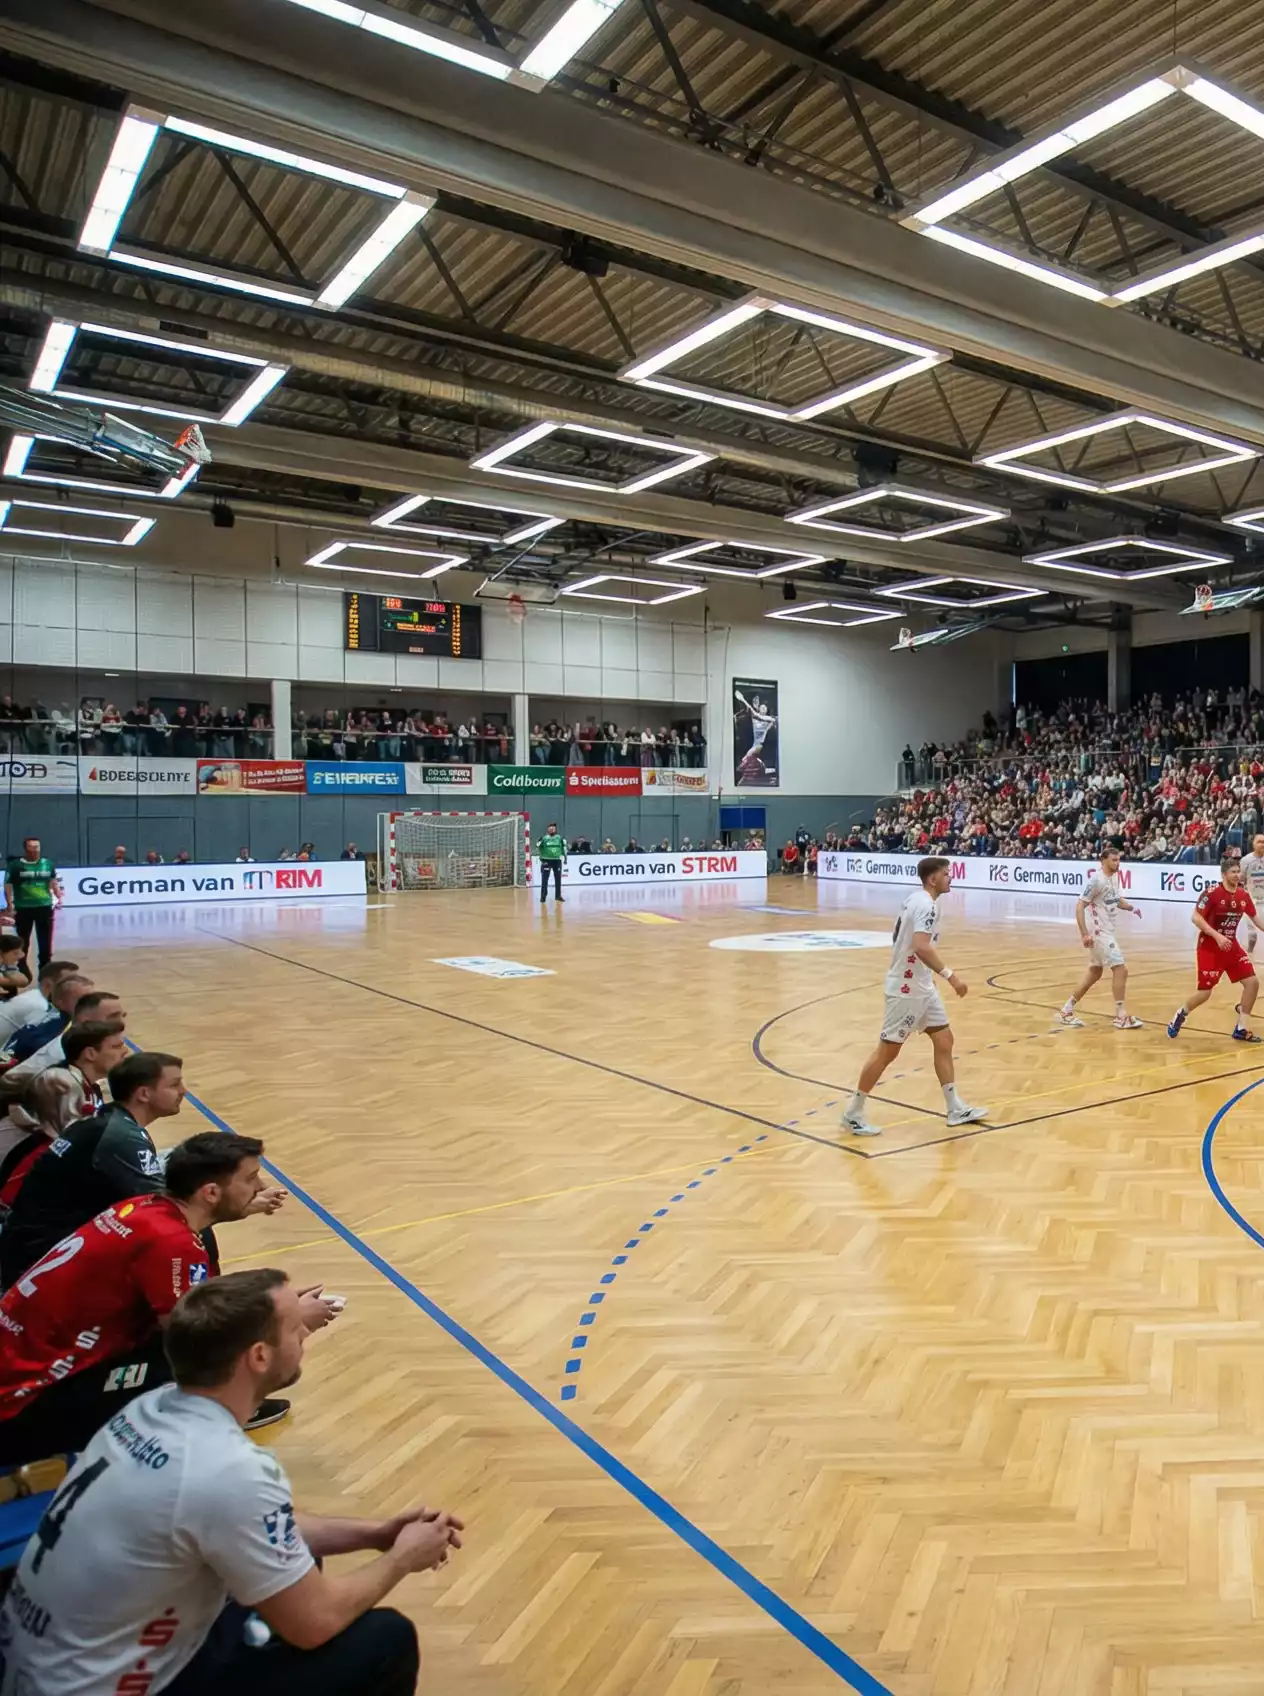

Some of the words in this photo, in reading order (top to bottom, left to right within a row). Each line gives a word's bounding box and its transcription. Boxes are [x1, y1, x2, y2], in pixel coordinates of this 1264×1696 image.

[578, 861, 645, 876] German
[649, 862, 675, 875] van
[682, 856, 738, 873] STRM
[866, 860, 903, 876] German
[1014, 866, 1059, 885] German
[1062, 872, 1083, 886] van
[78, 875, 185, 896] German
[192, 877, 235, 892] van
